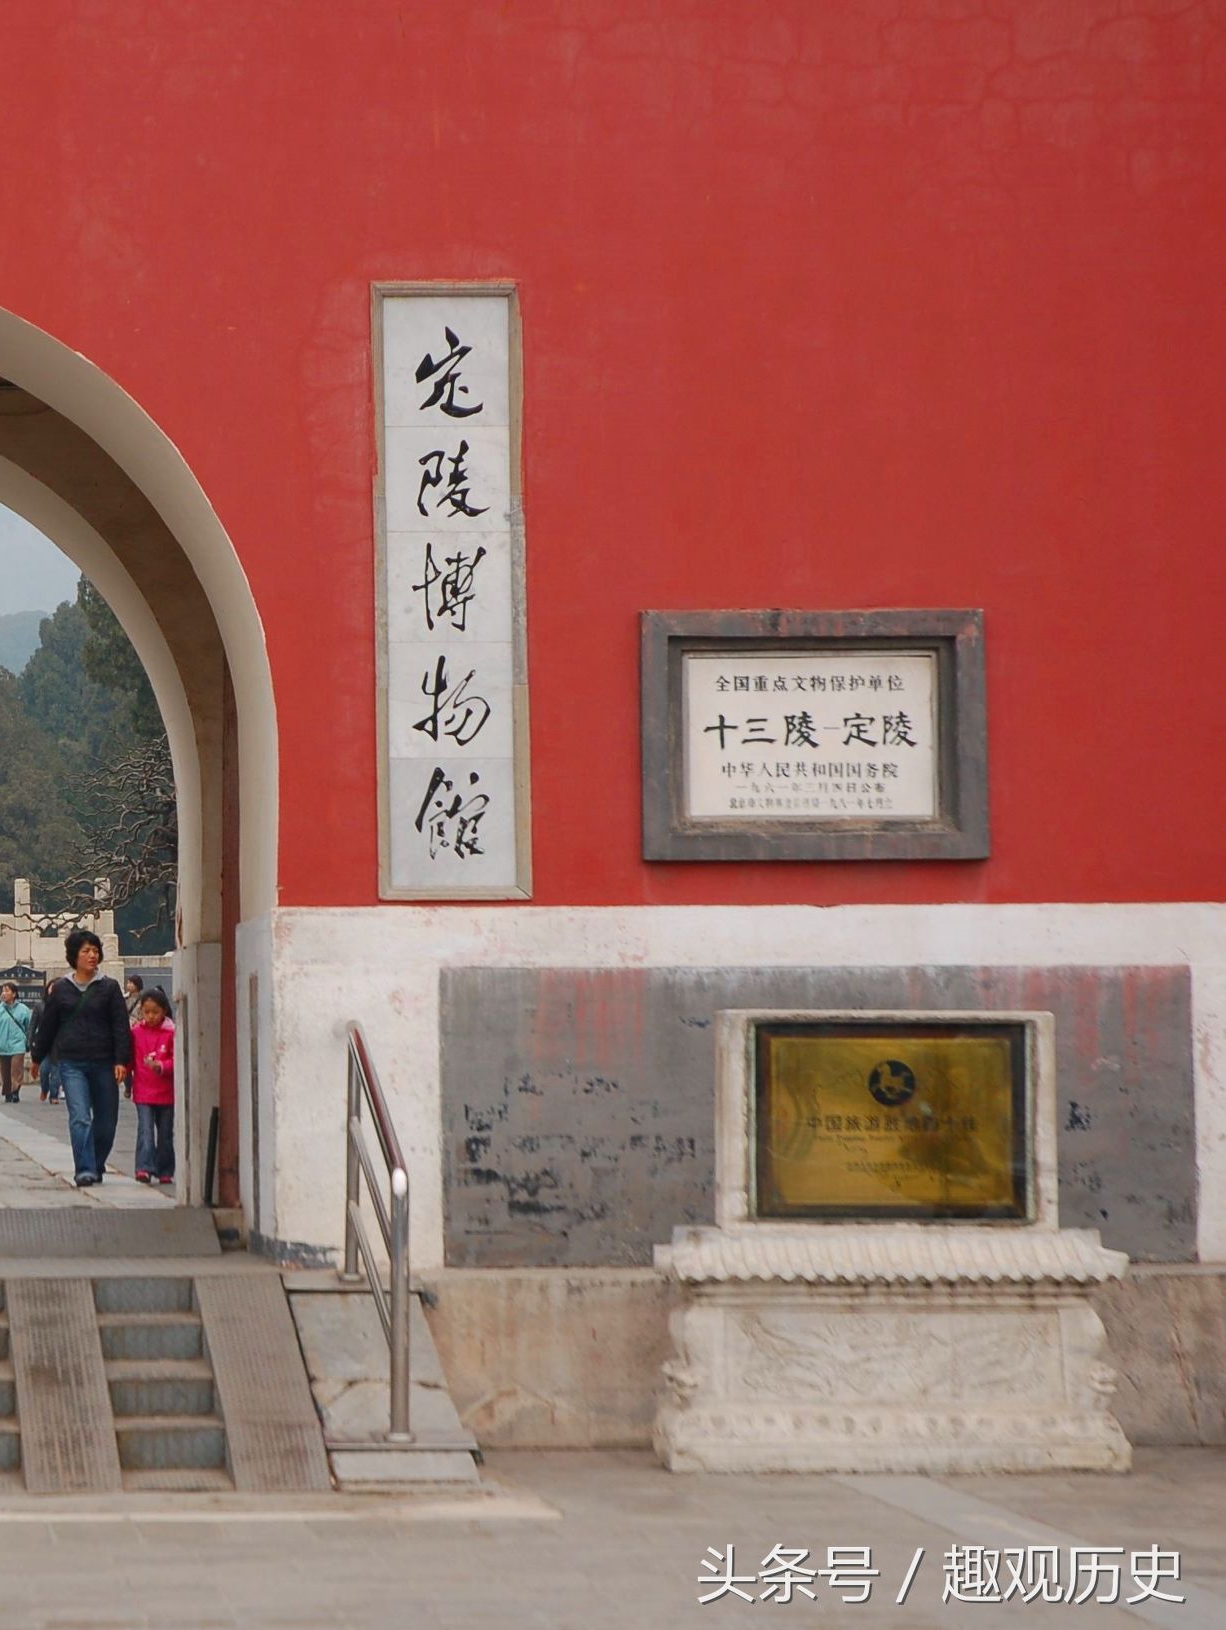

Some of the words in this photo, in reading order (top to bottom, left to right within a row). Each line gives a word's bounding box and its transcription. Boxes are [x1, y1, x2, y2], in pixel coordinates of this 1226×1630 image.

[715, 674, 905, 692] 全国重点文物保护单位
[722, 761, 899, 779] 中华人民共和国国务院
